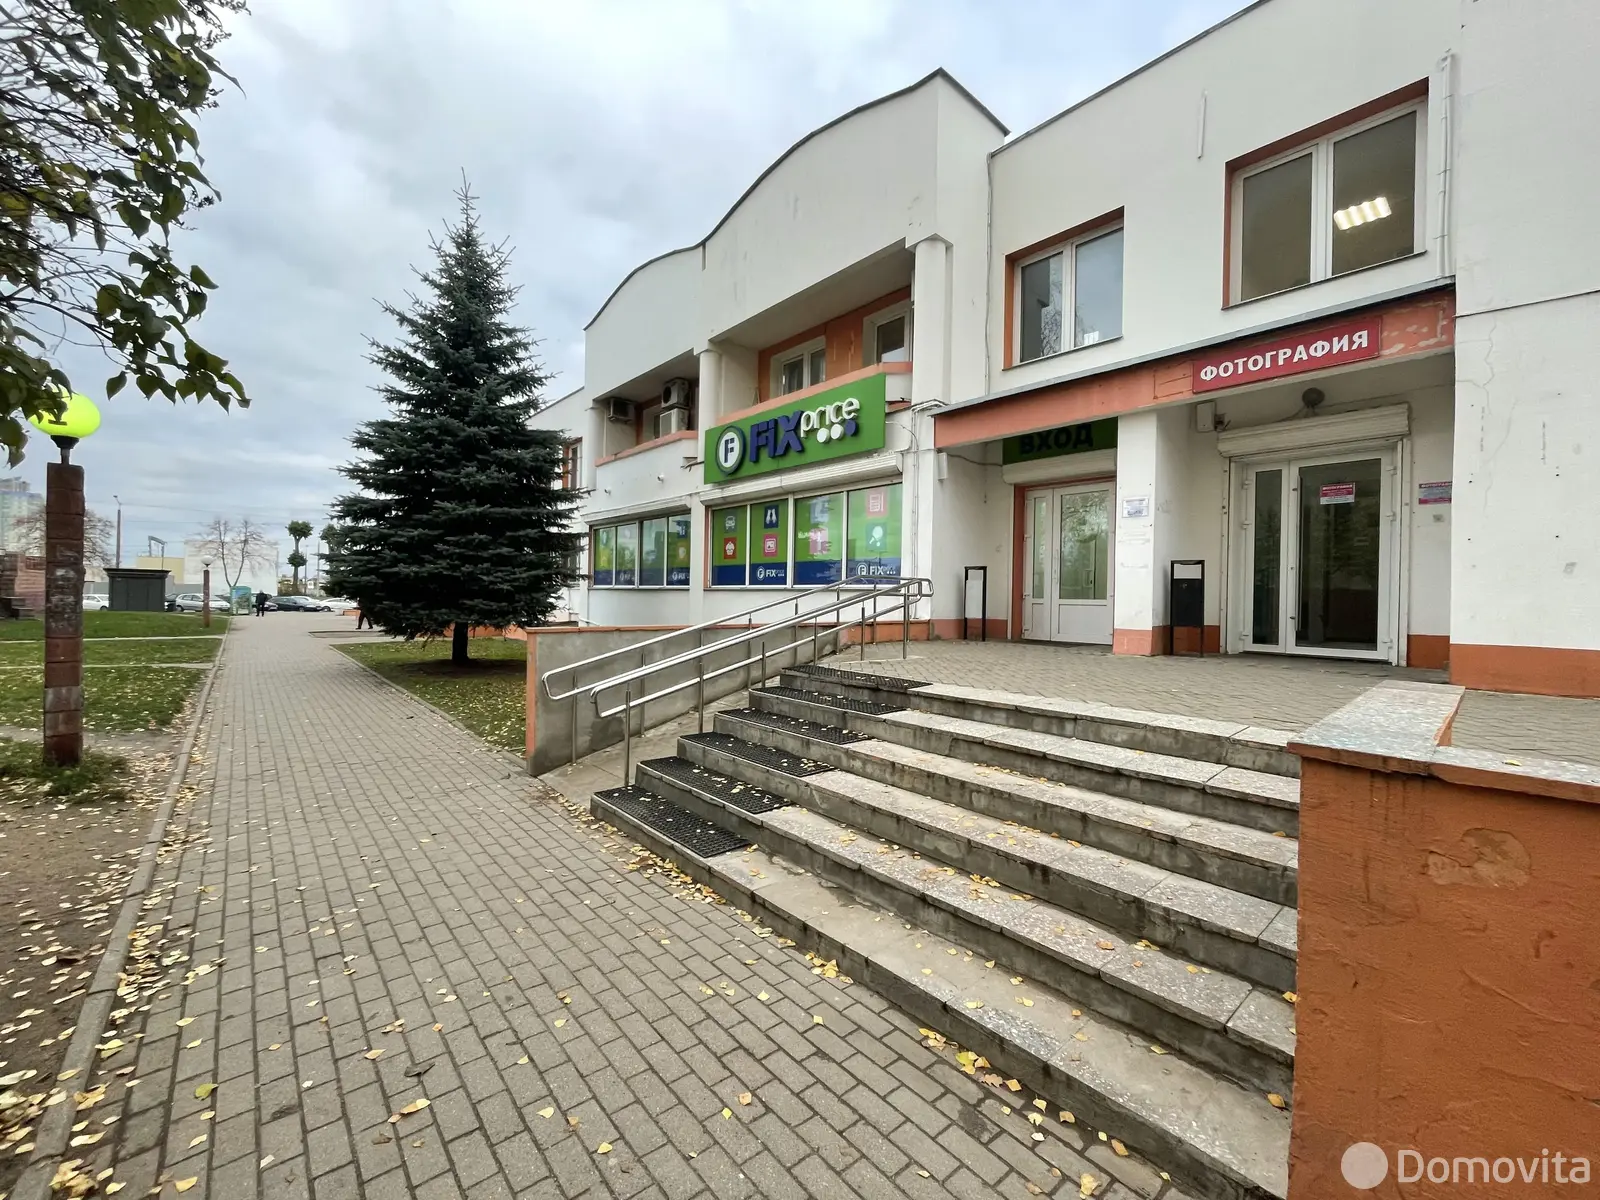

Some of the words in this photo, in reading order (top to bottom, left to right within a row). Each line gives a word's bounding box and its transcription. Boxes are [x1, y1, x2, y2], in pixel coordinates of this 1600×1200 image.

[1200, 330, 1368, 381] ФОТОГРАФИЯ
[800, 397, 861, 438] price
[1020, 423, 1094, 454] ВХОД
